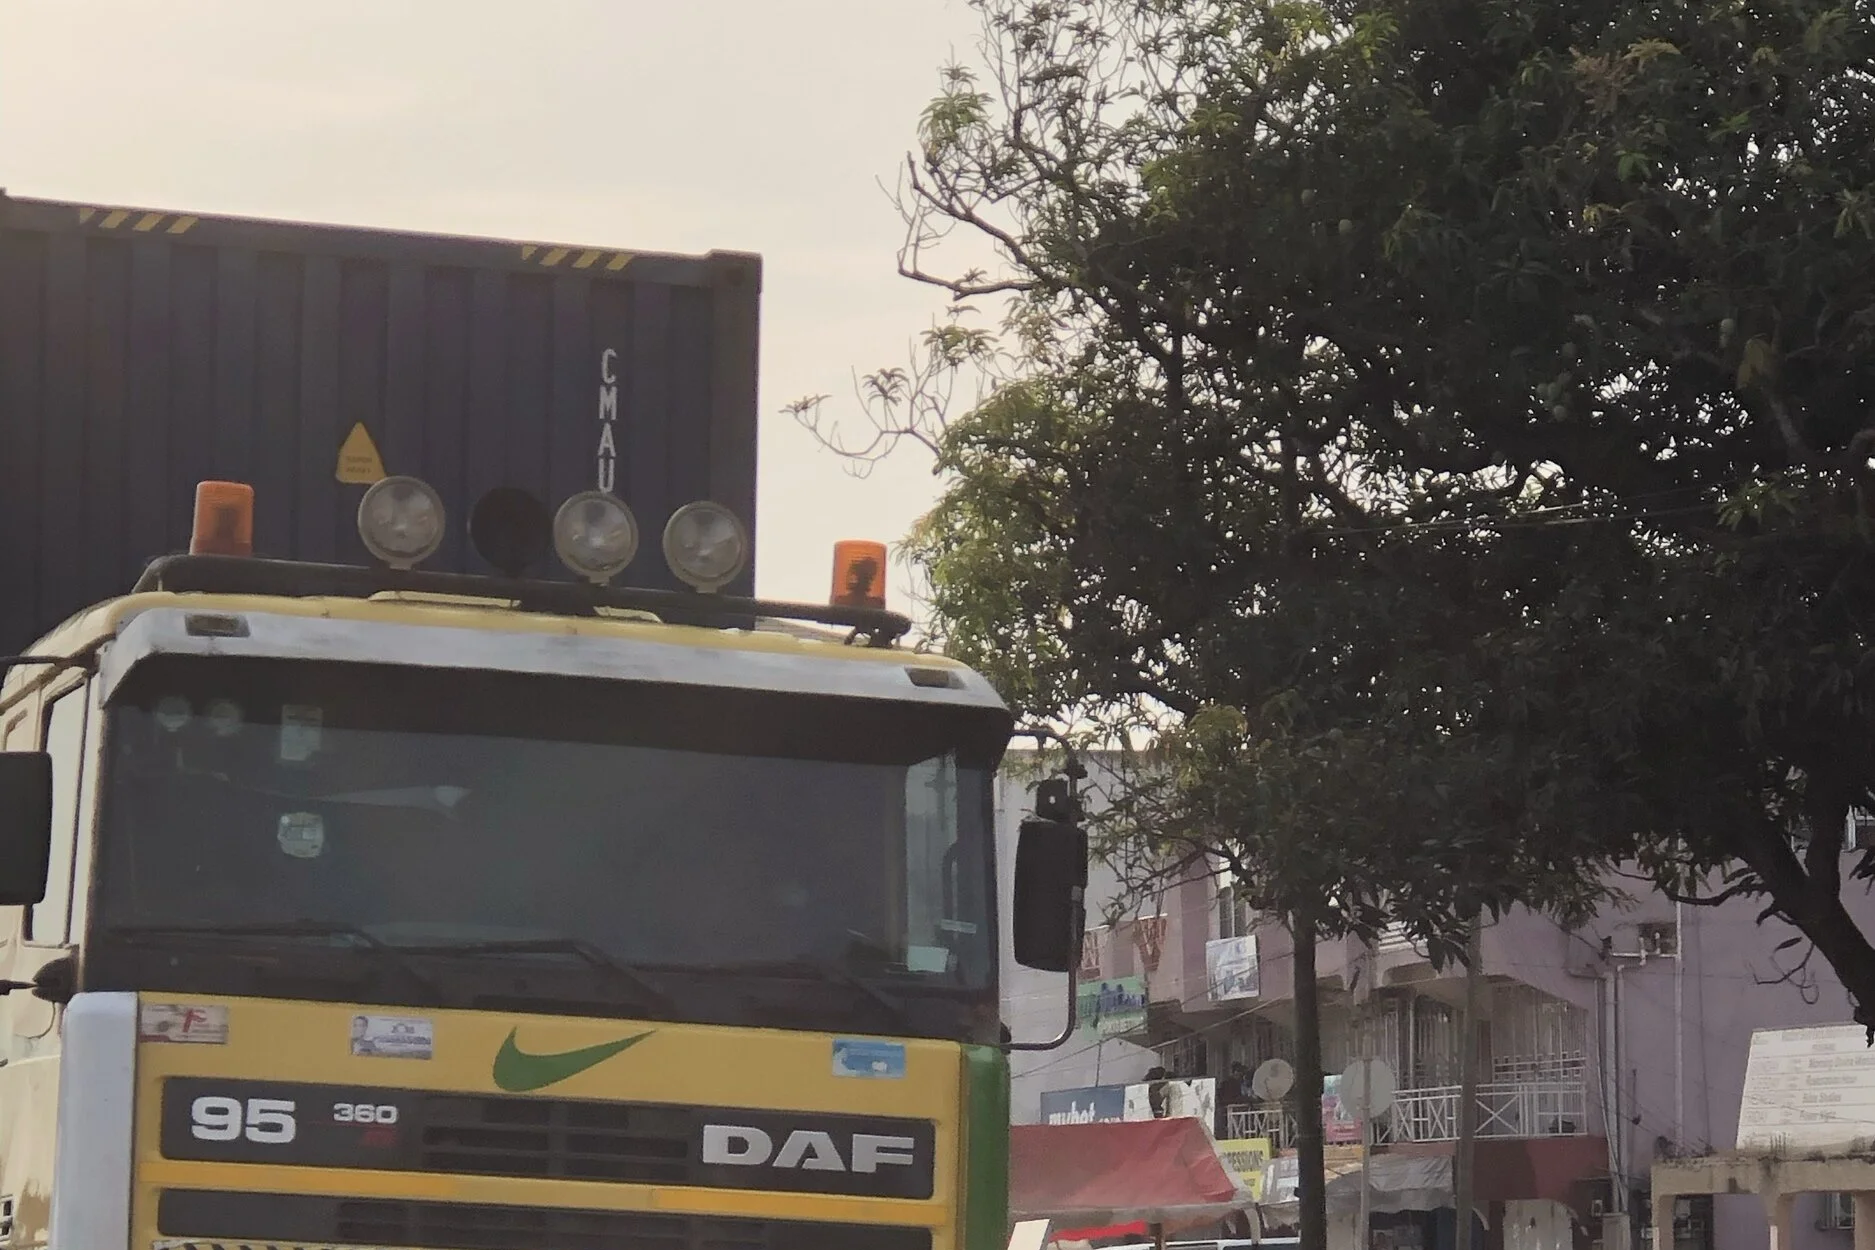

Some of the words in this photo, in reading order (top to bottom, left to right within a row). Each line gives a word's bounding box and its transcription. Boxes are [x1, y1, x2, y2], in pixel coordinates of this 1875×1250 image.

[598, 348, 617, 493] CMAU
[191, 1096, 296, 1144] 95
[333, 1102, 398, 1124] 360
[702, 1124, 914, 1173] DAF
